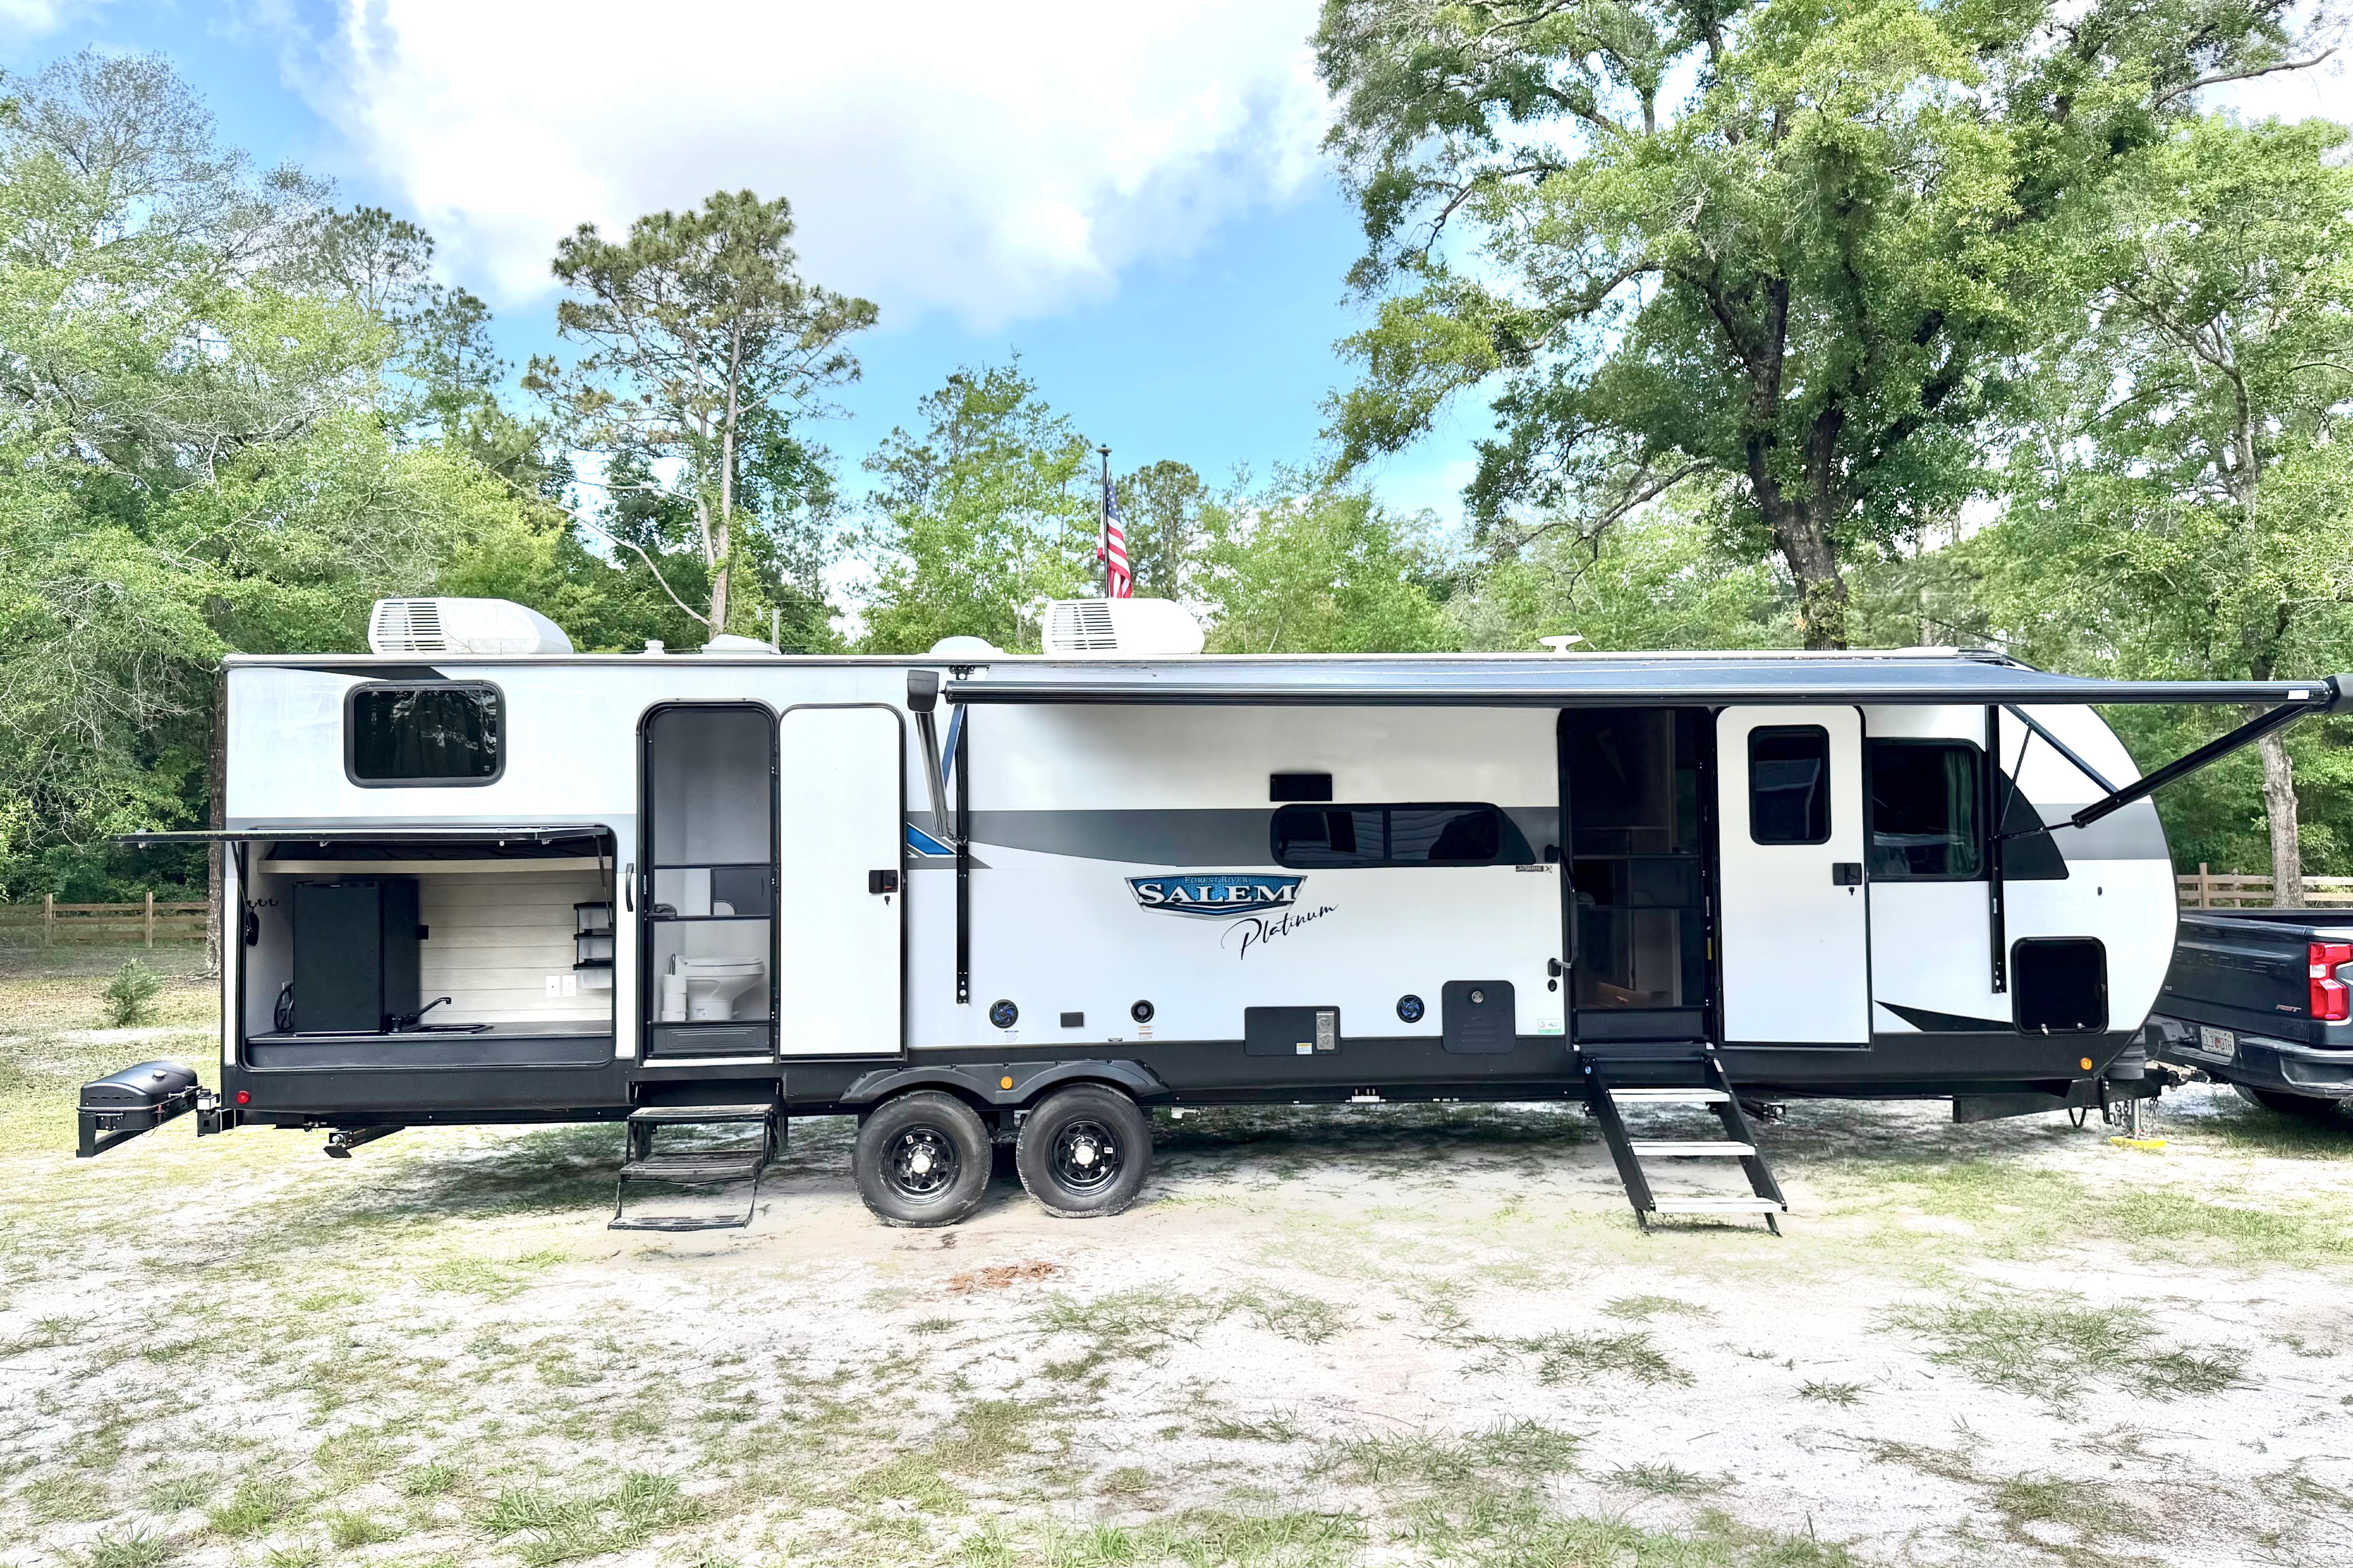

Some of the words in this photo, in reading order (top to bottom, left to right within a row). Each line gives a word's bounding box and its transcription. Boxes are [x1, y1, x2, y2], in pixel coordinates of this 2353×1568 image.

[1137, 883, 1297, 905] SALEM
[1221, 903, 1339, 961] Platinum
[2174, 950, 2288, 975] EVROLET
